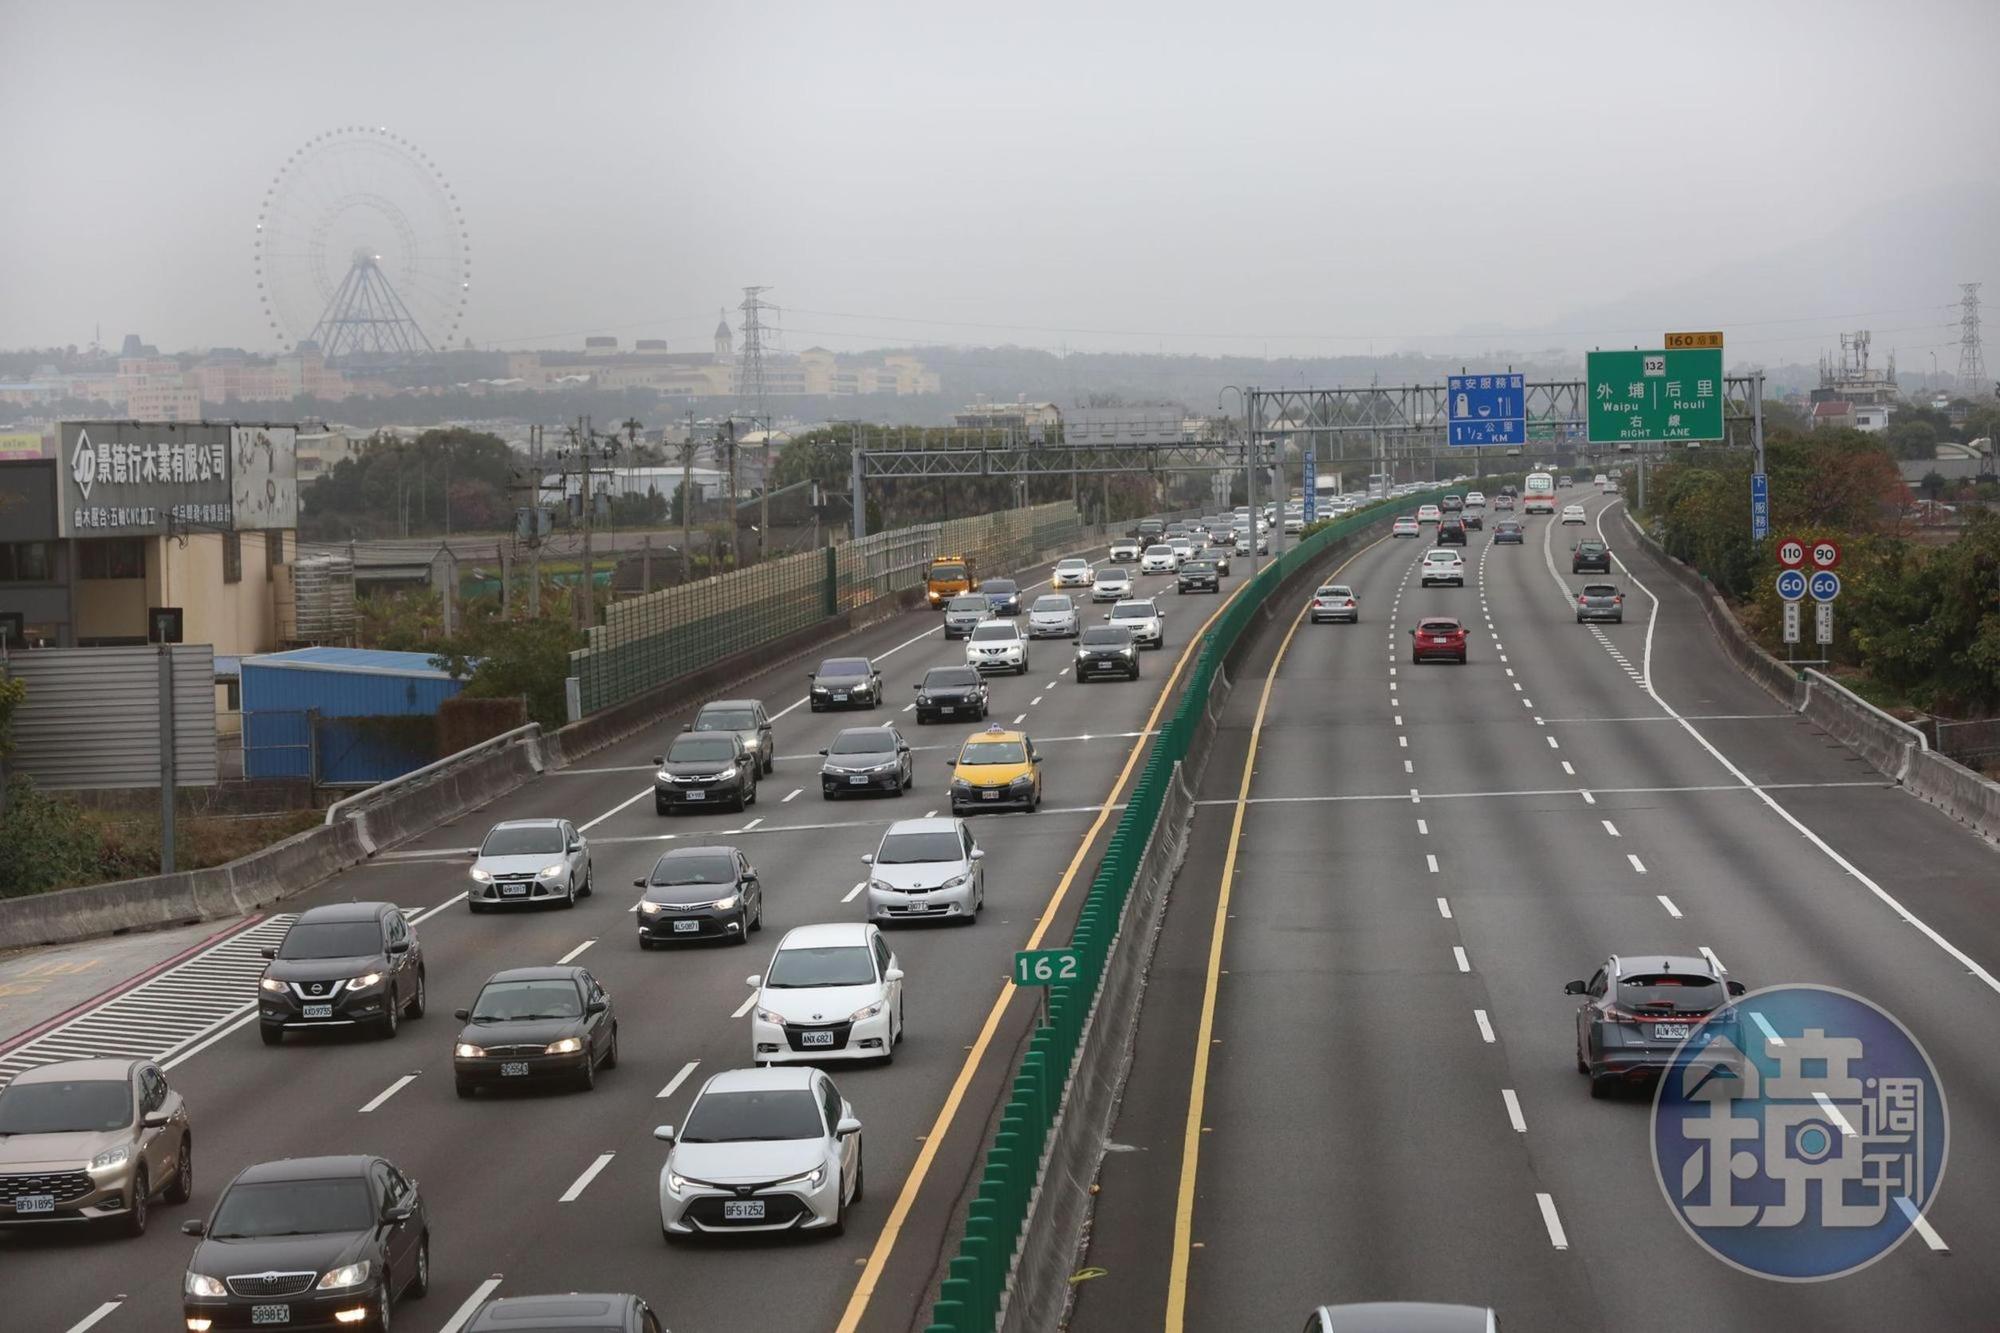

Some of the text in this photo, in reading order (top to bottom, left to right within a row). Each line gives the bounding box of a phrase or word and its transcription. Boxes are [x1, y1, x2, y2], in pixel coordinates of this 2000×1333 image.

[1669, 335, 1694, 346] 160
[1645, 361, 1664, 371] 132
[1450, 376, 1522, 390] 泰安服務區
[1596, 381, 1645, 399] 外埔
[1665, 380, 1714, 398] 后里
[1603, 401, 1639, 412] Waipu
[1674, 400, 1706, 410] Houli
[1486, 421, 1513, 432] 公里
[1491, 434, 1508, 442] KM
[1621, 428, 1690, 438] RIGHT LANE
[97, 442, 226, 485] 景德行木業有限公司
[1783, 548, 1801, 559] 110
[1816, 549, 1834, 560] 90
[1781, 579, 1802, 592] 60
[1814, 581, 1835, 593] 60
[1019, 956, 1077, 981] 162
